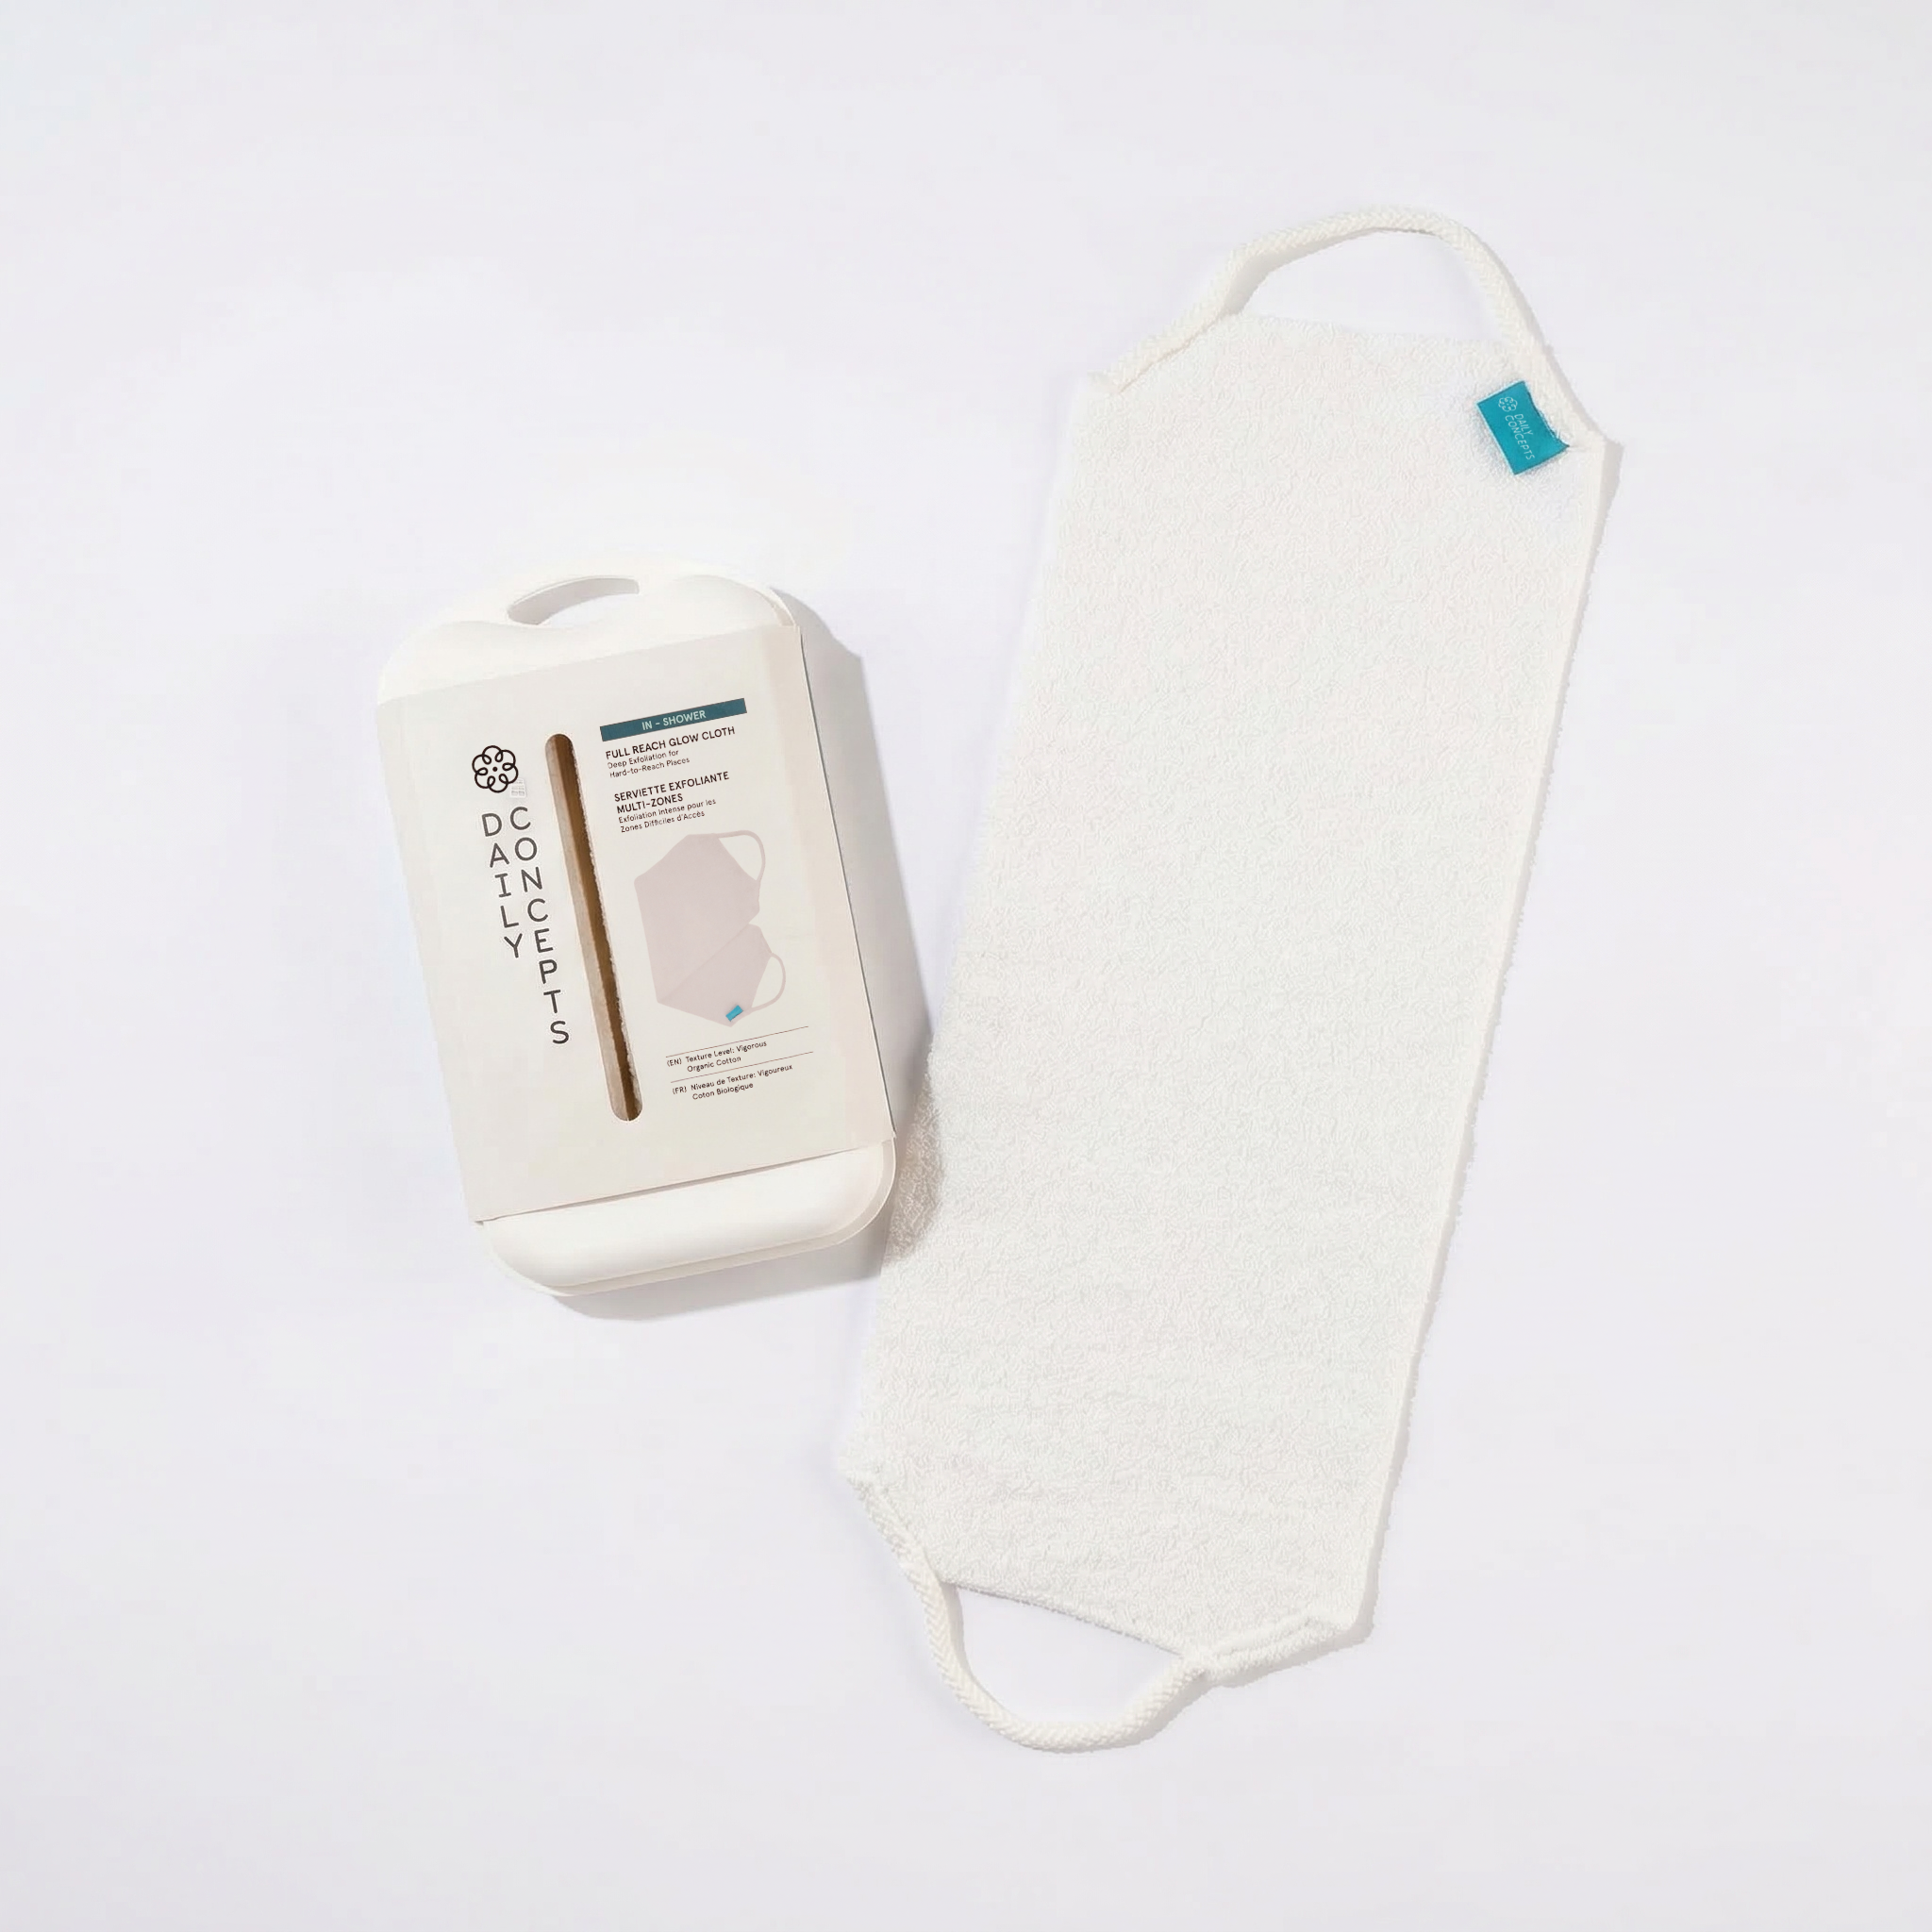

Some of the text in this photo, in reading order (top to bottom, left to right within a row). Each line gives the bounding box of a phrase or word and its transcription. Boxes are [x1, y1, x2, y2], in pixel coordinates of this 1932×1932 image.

[1514, 414, 1533, 435] DAILY
[1505, 415, 1535, 460] CONCEPTS
[642, 721, 652, 731] IN
[663, 710, 706, 726] SHOWER
[606, 726, 735, 760] FULL REACH GLOW CLOTH
[607, 760, 627, 769] Deep
[629, 752, 667, 765] Exfoliation
[610, 758, 690, 778] Hard-to-Reach Places
[614, 771, 729, 802] SERVIETTE EXFOLIANTE
[617, 793, 683, 814] MULTI-ZONES
[618, 811, 657, 823] Exfoliation
[687, 802, 704, 811] pour
[621, 811, 705, 833] Zones Difficiles d'Accès
[481, 812, 523, 959] DAILY
[509, 806, 570, 1044] CONCEPTS
[666, 1041, 767, 1067] (EN) Texture Level: Vigorous
[687, 1055, 741, 1072] Organic Cotton
[672, 1086, 687, 1095] (FR)
[691, 1081, 715, 1091] Niveau
[727, 1072, 756, 1083] Texture:
[757, 1064, 793, 1076] Vigoureux
[692, 1083, 754, 1100] Coton Biologique
